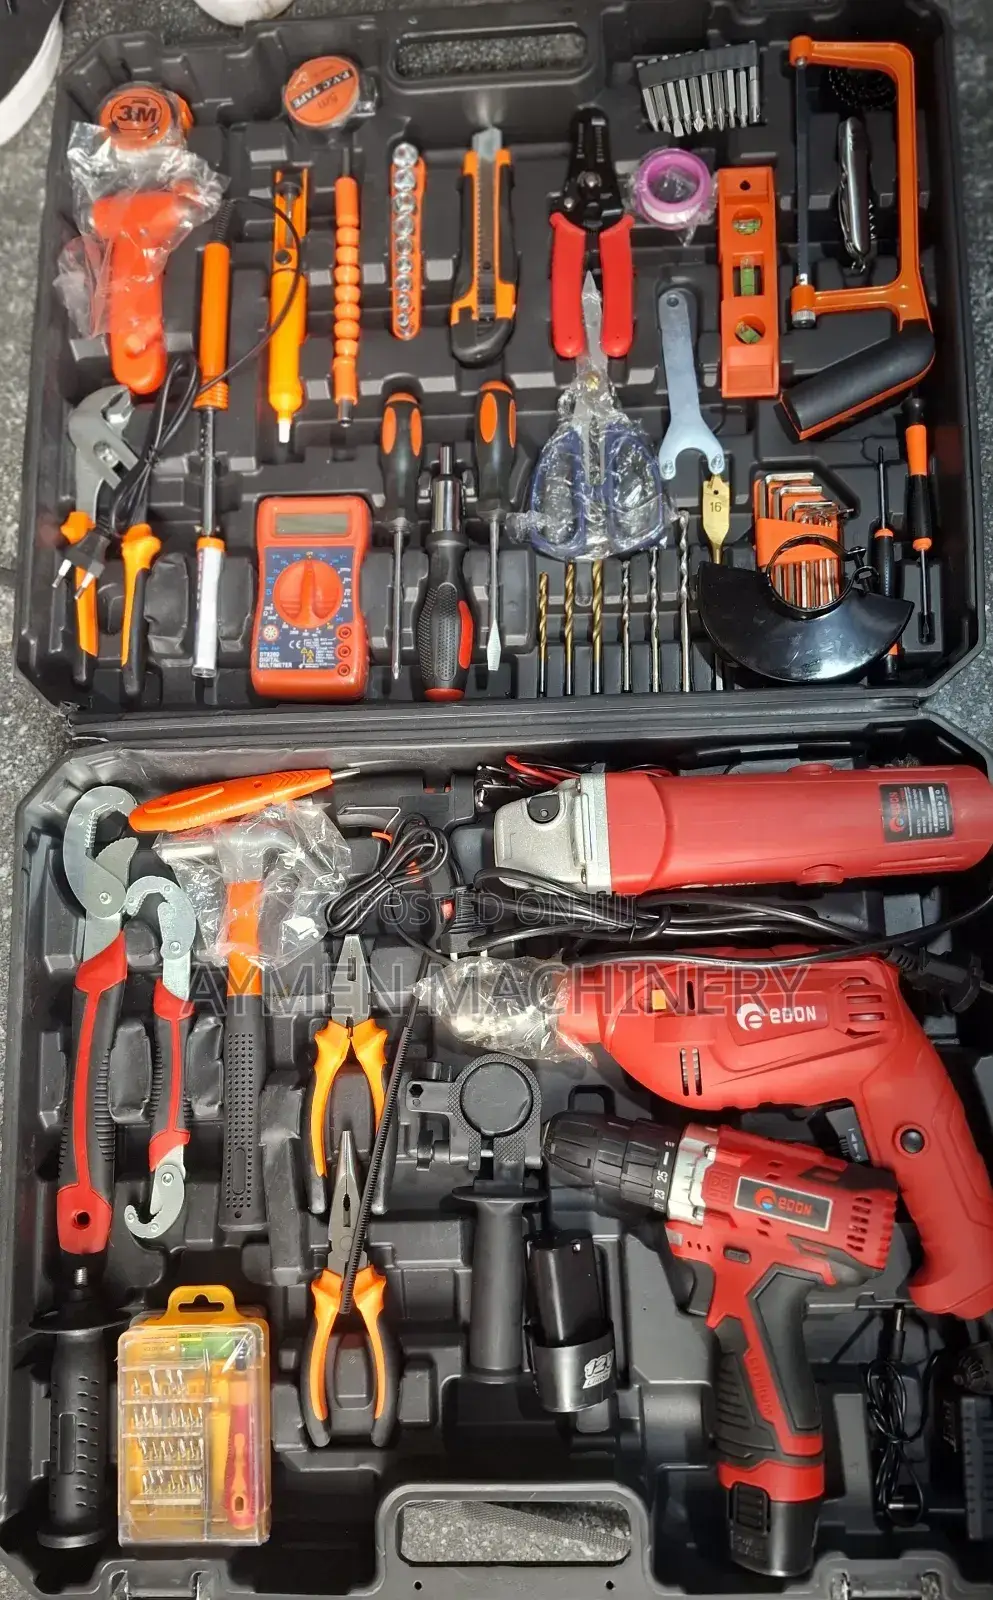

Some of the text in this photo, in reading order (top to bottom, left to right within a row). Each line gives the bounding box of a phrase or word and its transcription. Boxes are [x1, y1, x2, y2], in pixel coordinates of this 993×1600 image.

[292, 87, 320, 108] TAPE
[116, 104, 157, 123] 3M
[710, 501, 722, 513] 16
[656, 1170, 669, 1183] 25
[653, 1188, 666, 1200] 23
